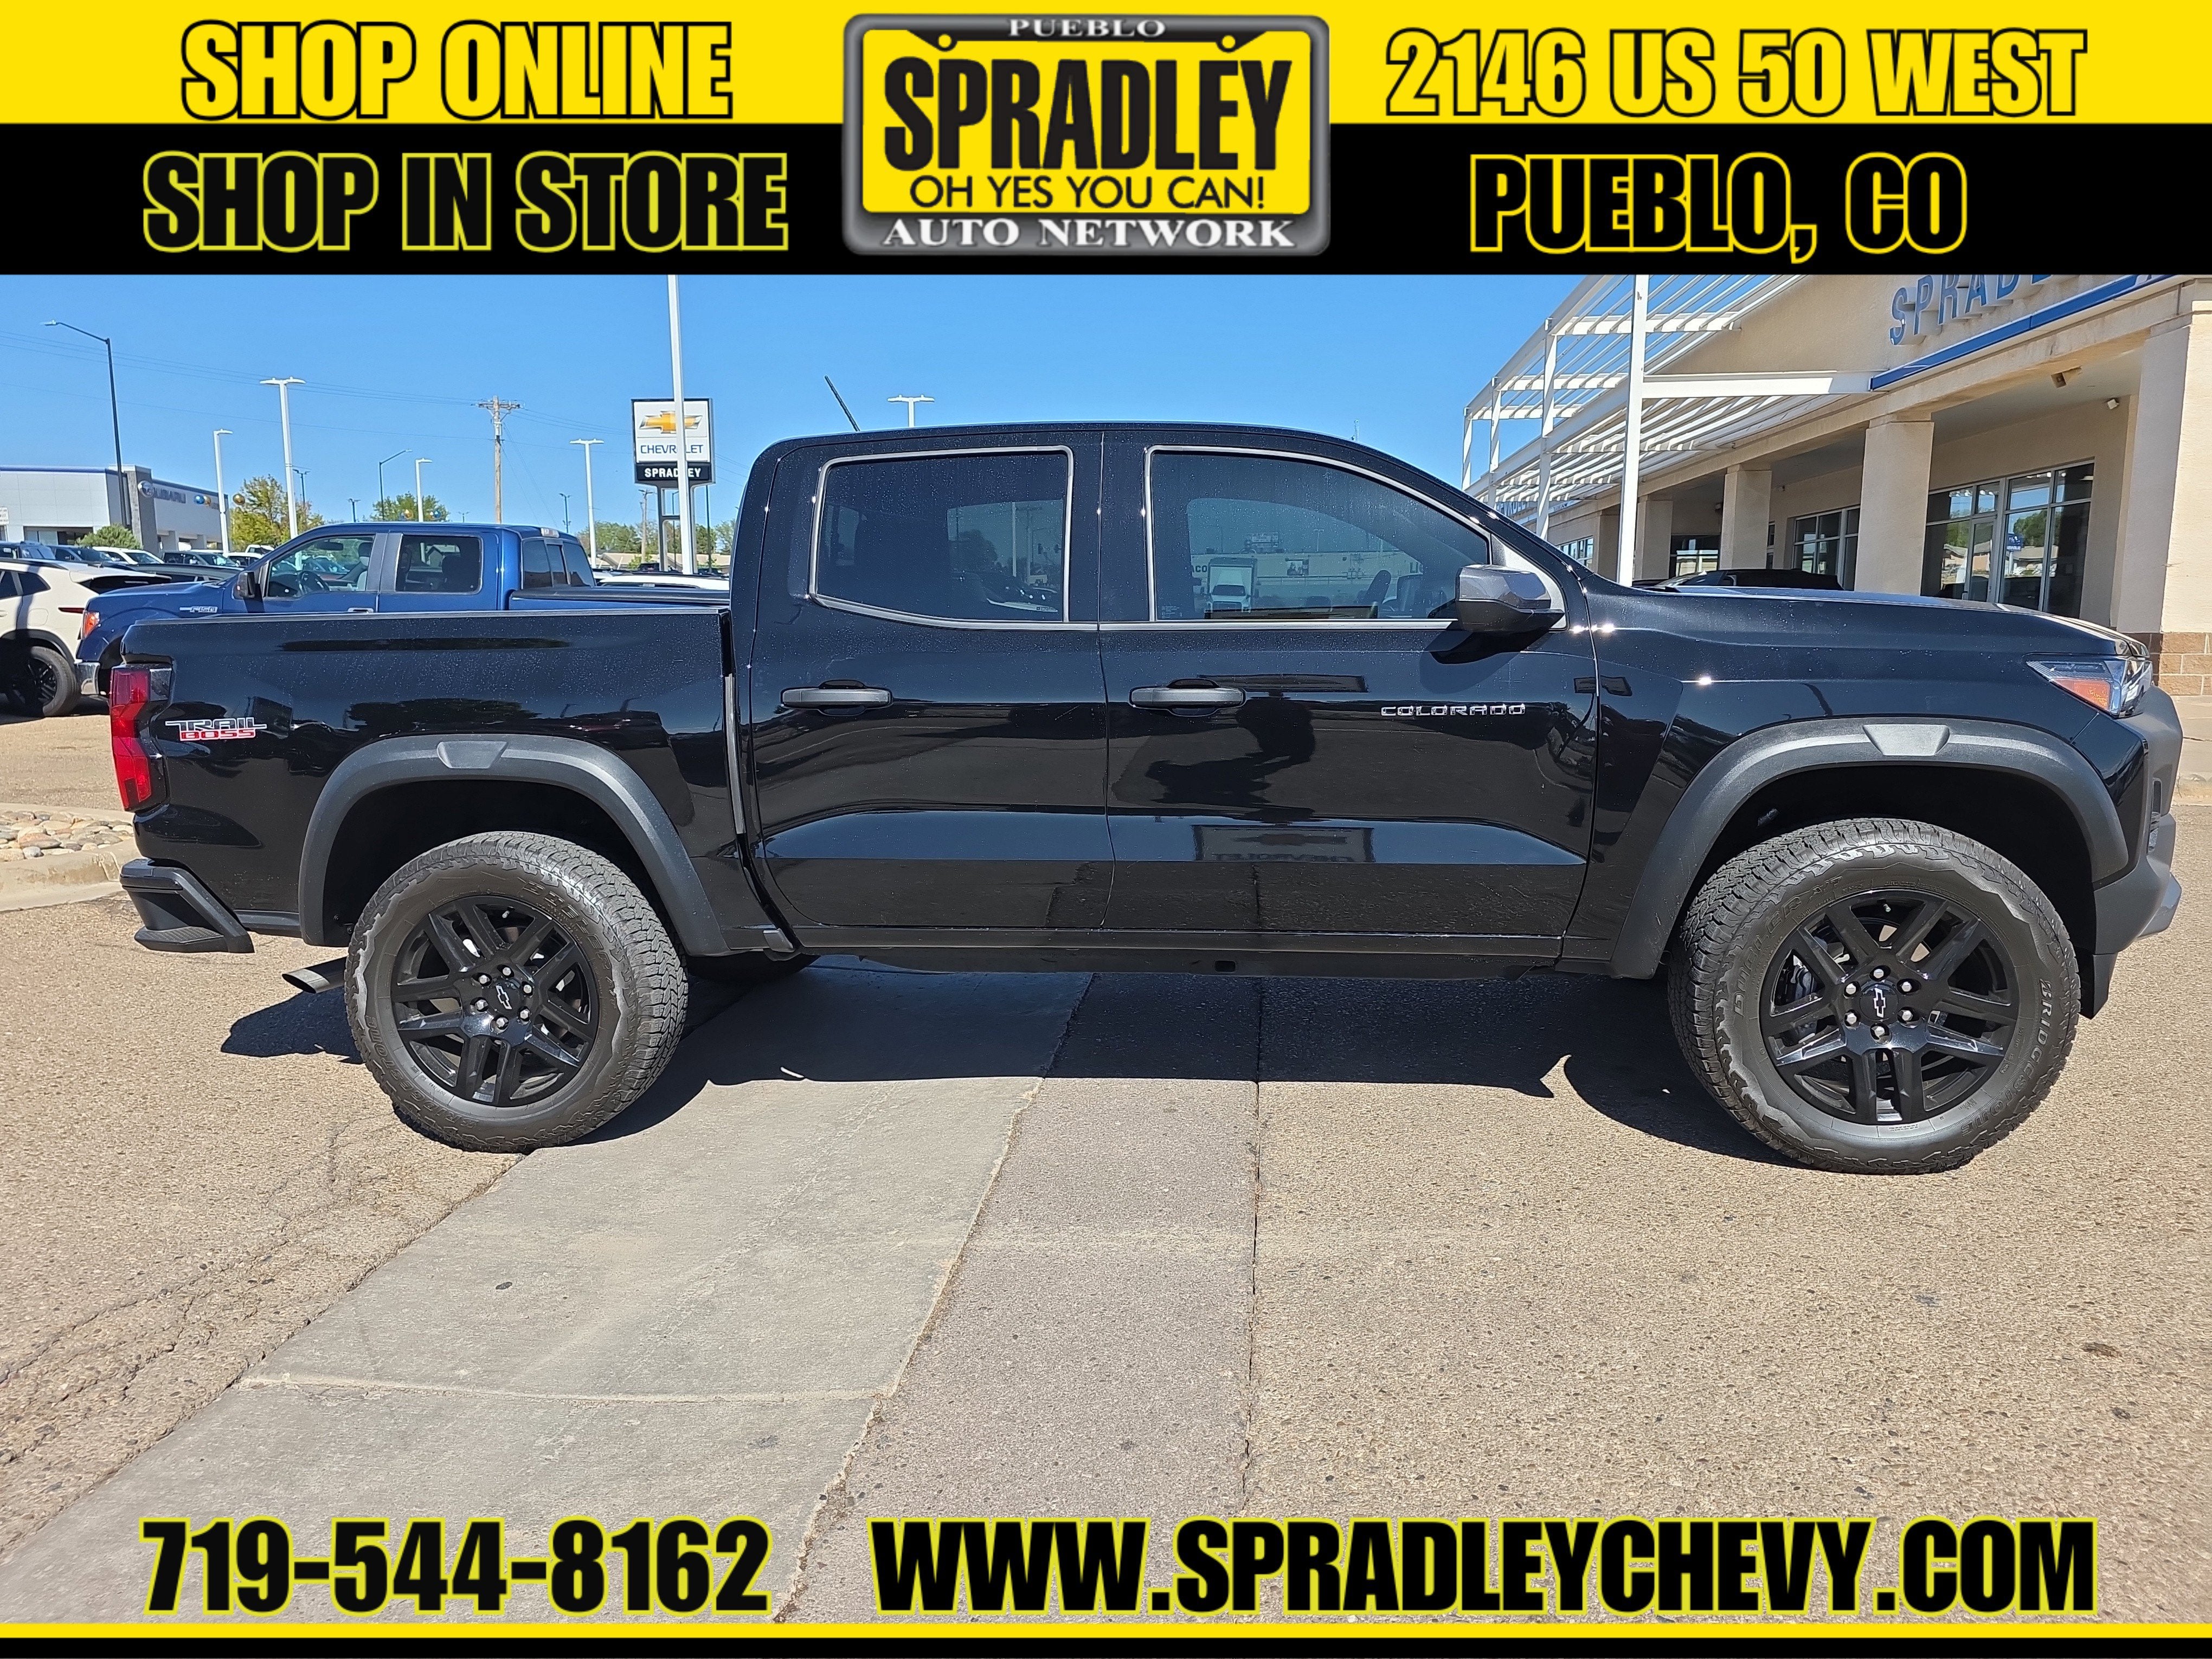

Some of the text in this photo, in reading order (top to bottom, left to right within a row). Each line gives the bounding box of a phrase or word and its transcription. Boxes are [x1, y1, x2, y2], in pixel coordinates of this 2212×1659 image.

[640, 445, 704, 454] CHEVRLET
[645, 467, 701, 478] SPRADEY
[1381, 703, 1526, 716] COLORADO
[165, 717, 267, 732] TRAIL
[179, 729, 256, 741] BOSS
